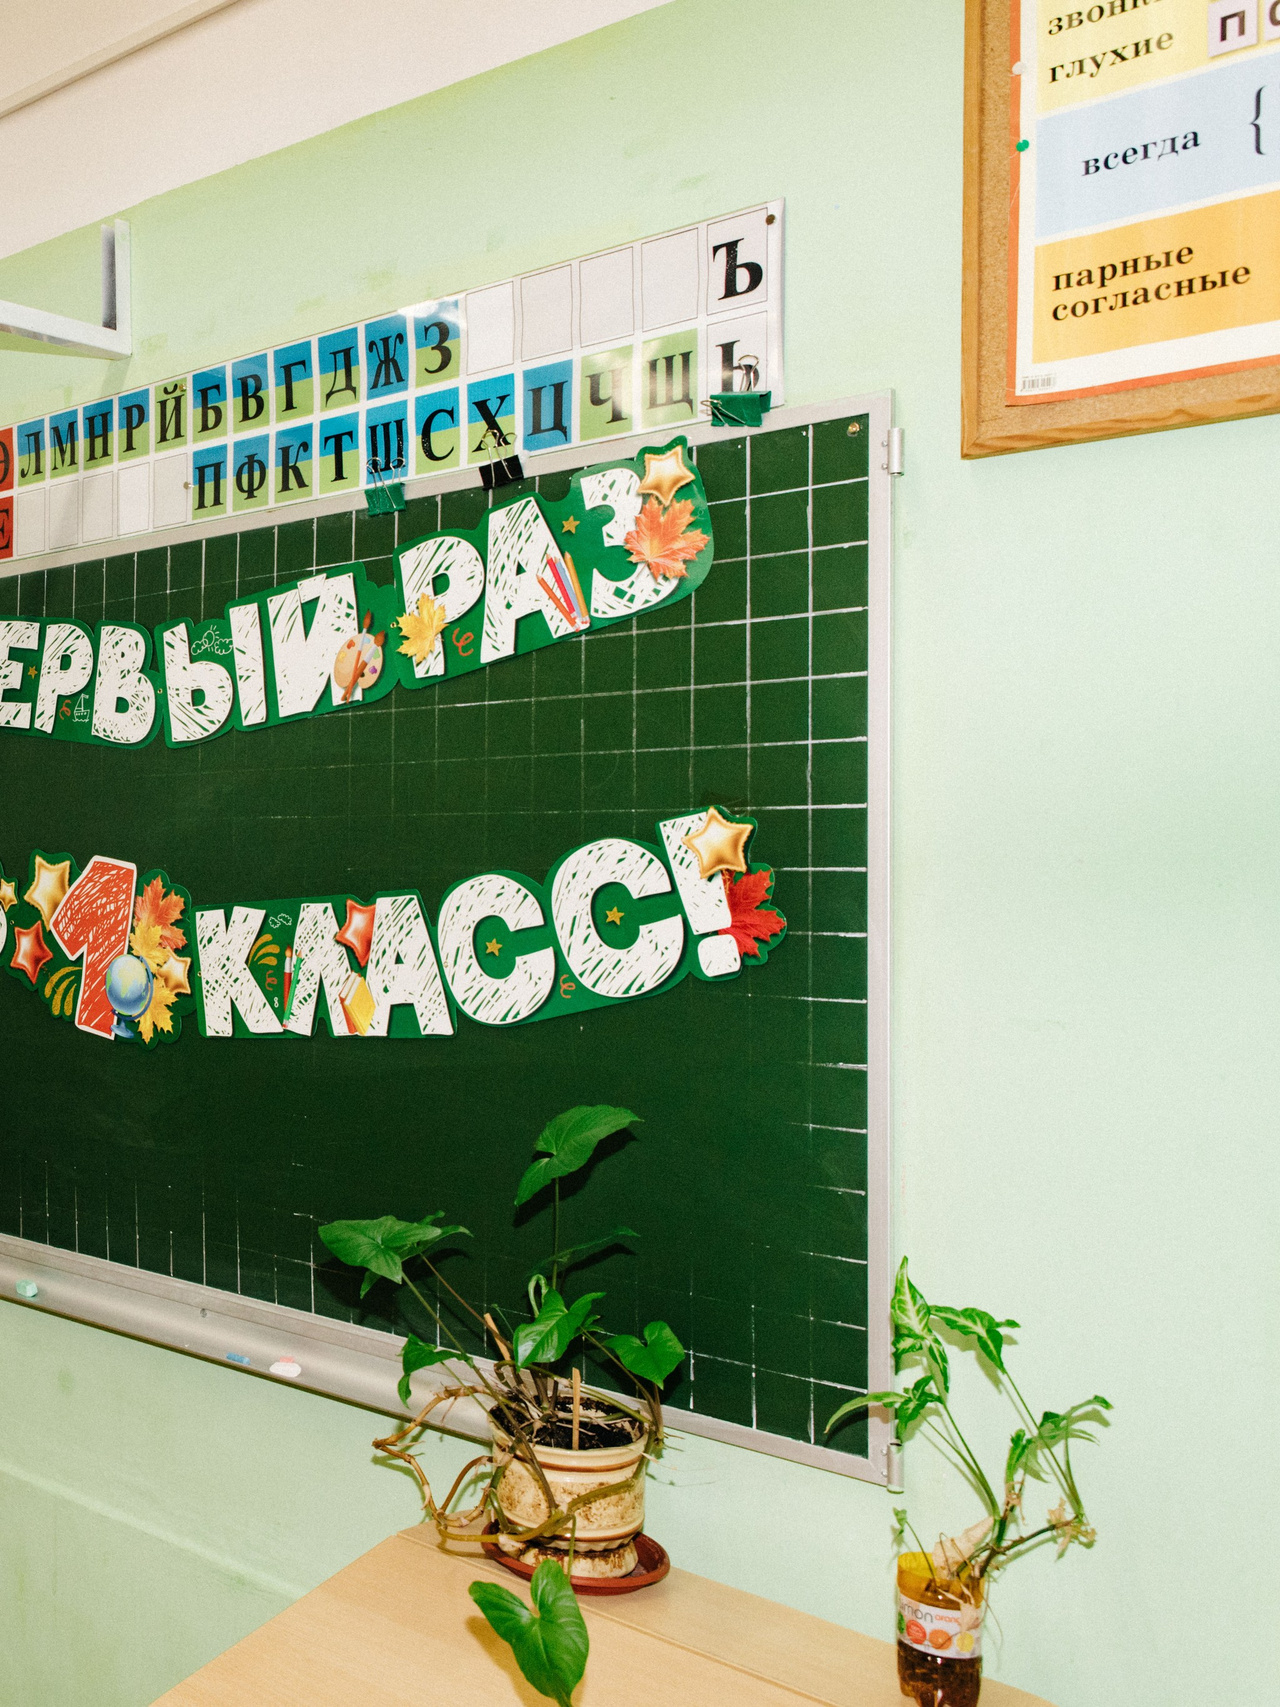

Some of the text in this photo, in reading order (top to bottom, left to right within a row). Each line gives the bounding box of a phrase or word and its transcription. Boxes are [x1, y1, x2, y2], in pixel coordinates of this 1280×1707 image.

[1047, 0, 1160, 35] звон
[1048, 31, 1175, 84] глухие
[1081, 130, 1201, 176] всегда
[1051, 246, 1194, 292] парные
[1051, 265, 1252, 322] согласные
[20, 430, 43, 478] Л
[51, 420, 78, 471] М
[85, 411, 111, 462] Н
[122, 403, 146, 453] Р
[156, 383, 186, 444] Й
[197, 383, 223, 433] Б
[237, 373, 265, 423] В
[280, 359, 307, 413] Г
[325, 346, 357, 407] Д
[368, 332, 405, 390] Ж
[423, 321, 452, 375] З
[712, 237, 763, 301] Ъ
[194, 460, 225, 512] П
[235, 453, 267, 501] Ф
[277, 441, 310, 494] К
[323, 430, 355, 483] Т
[368, 418, 405, 475] Ш
[421, 405, 455, 462] С
[471, 393, 511, 453] Х
[526, 380, 569, 443] Ц
[585, 365, 629, 424] Ч
[646, 350, 694, 415] Щ
[398, 467, 680, 679] РАЗ
[49, 855, 137, 1041] 1
[195, 809, 742, 1038] КЛАСС!
